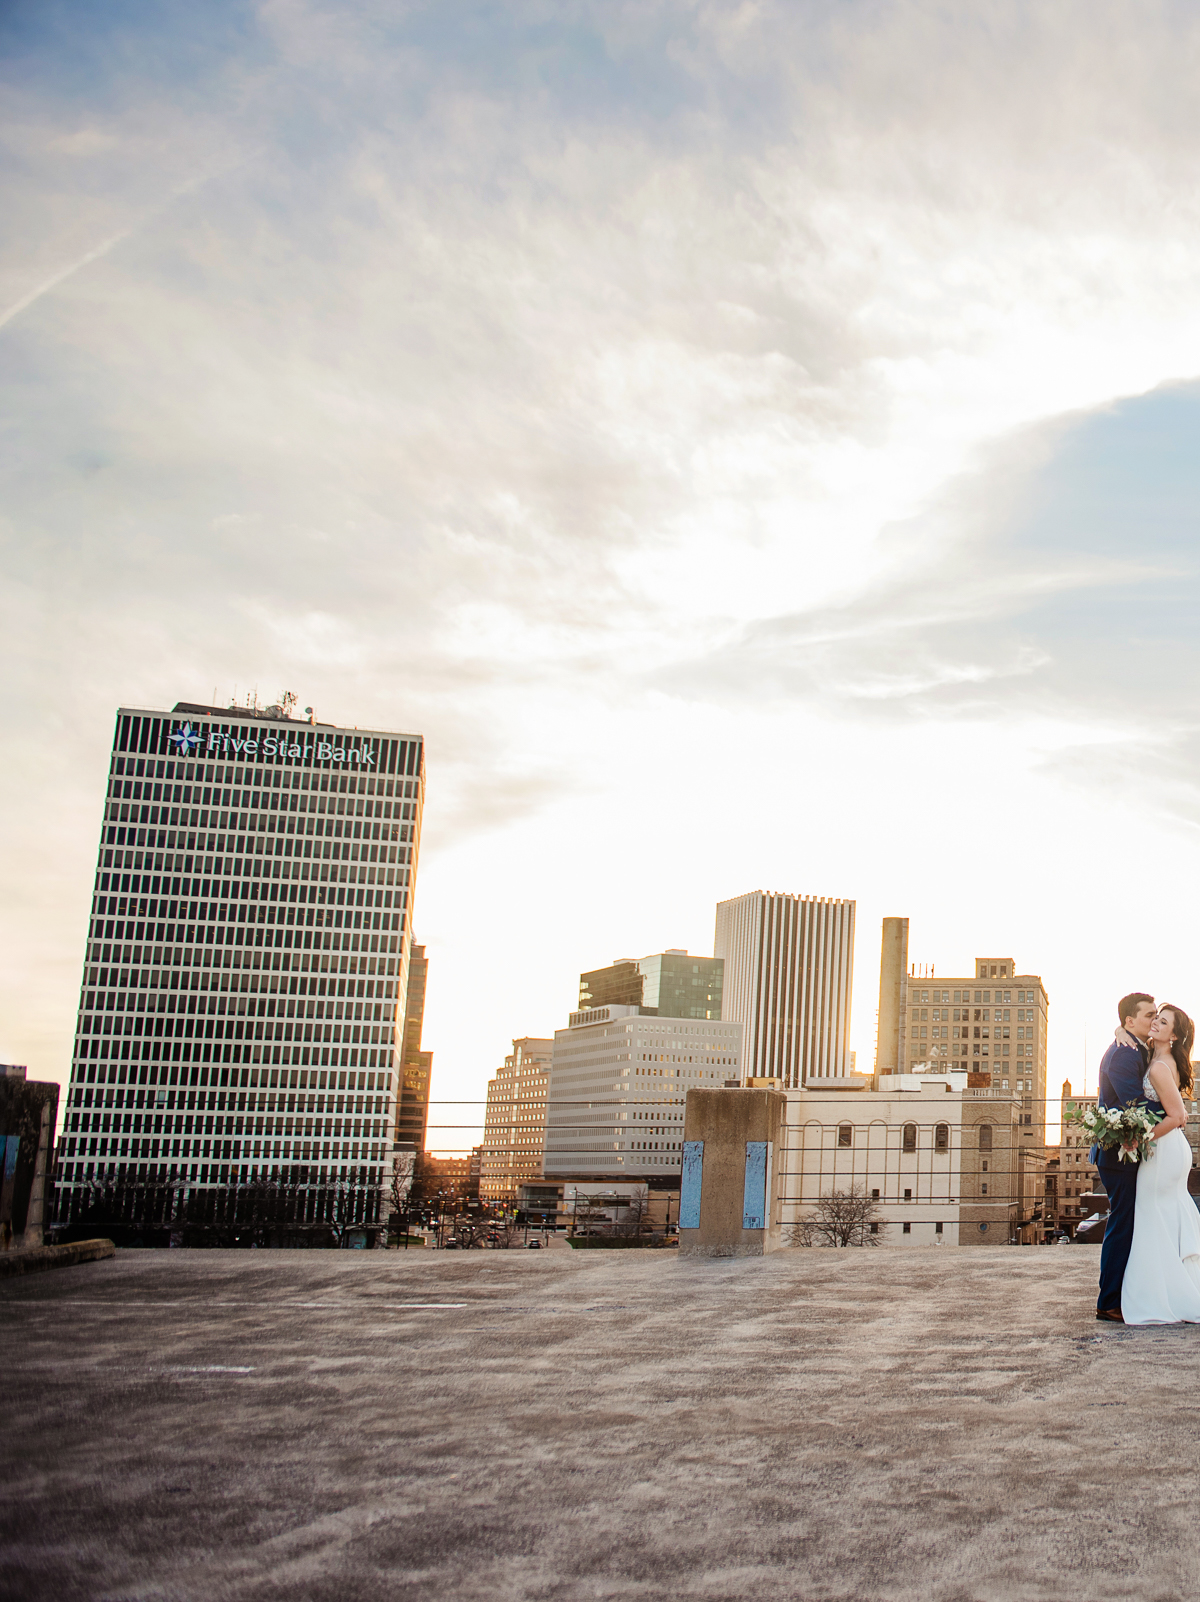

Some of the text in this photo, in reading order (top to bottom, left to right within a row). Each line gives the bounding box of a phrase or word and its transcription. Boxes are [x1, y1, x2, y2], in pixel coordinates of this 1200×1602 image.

[207, 732, 376, 765] Five Star Bank
